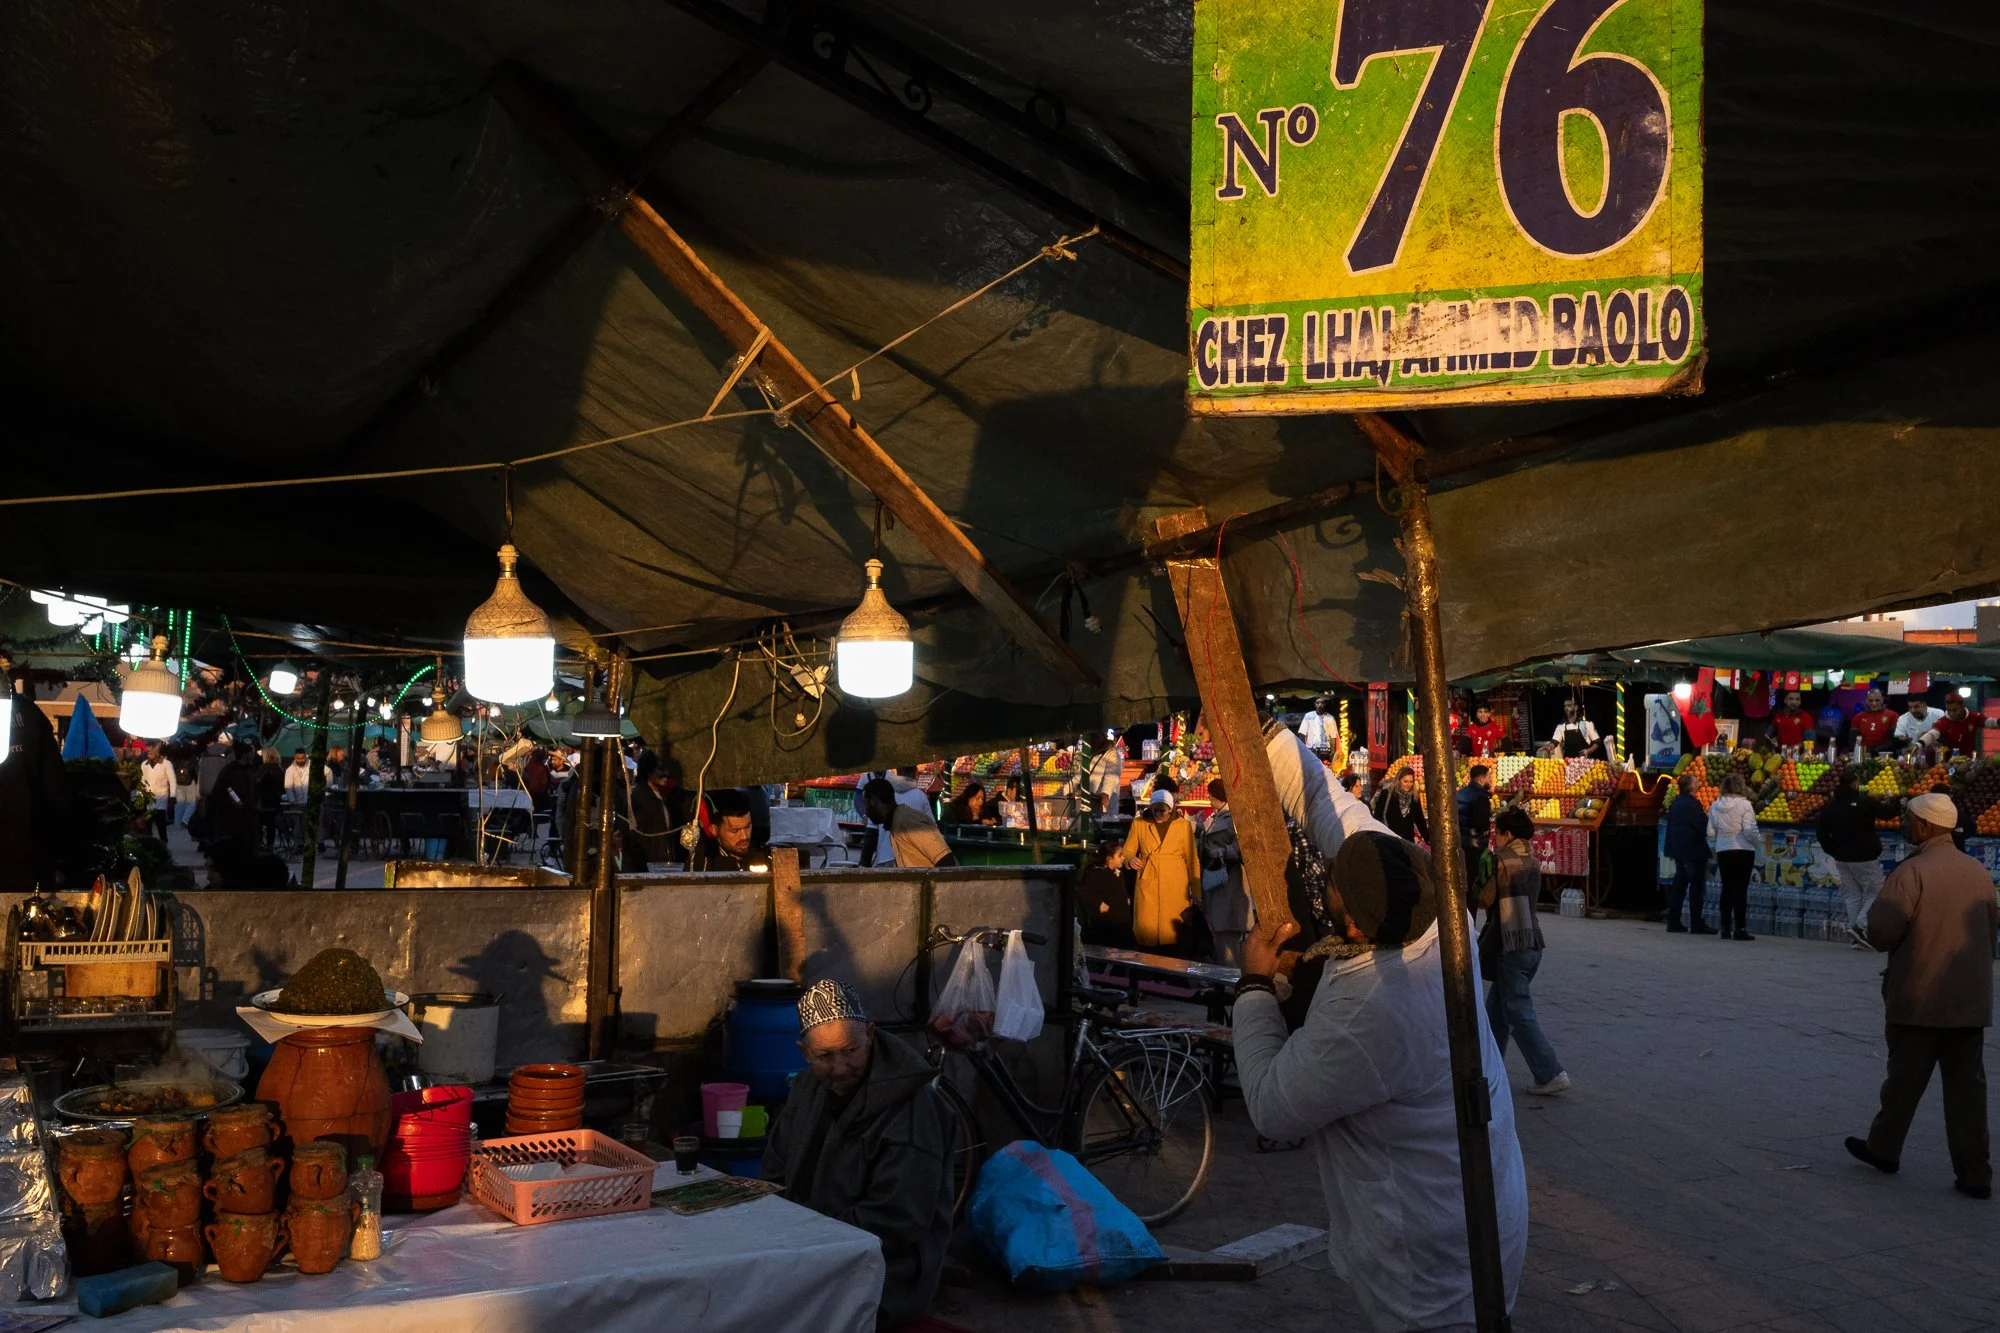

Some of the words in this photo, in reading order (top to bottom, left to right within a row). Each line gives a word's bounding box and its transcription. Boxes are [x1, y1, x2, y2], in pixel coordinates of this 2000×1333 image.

[1330, 0, 1671, 276] 76
[1197, 313, 1289, 389] CHEZ
[1549, 285, 1694, 369] BAOLO
